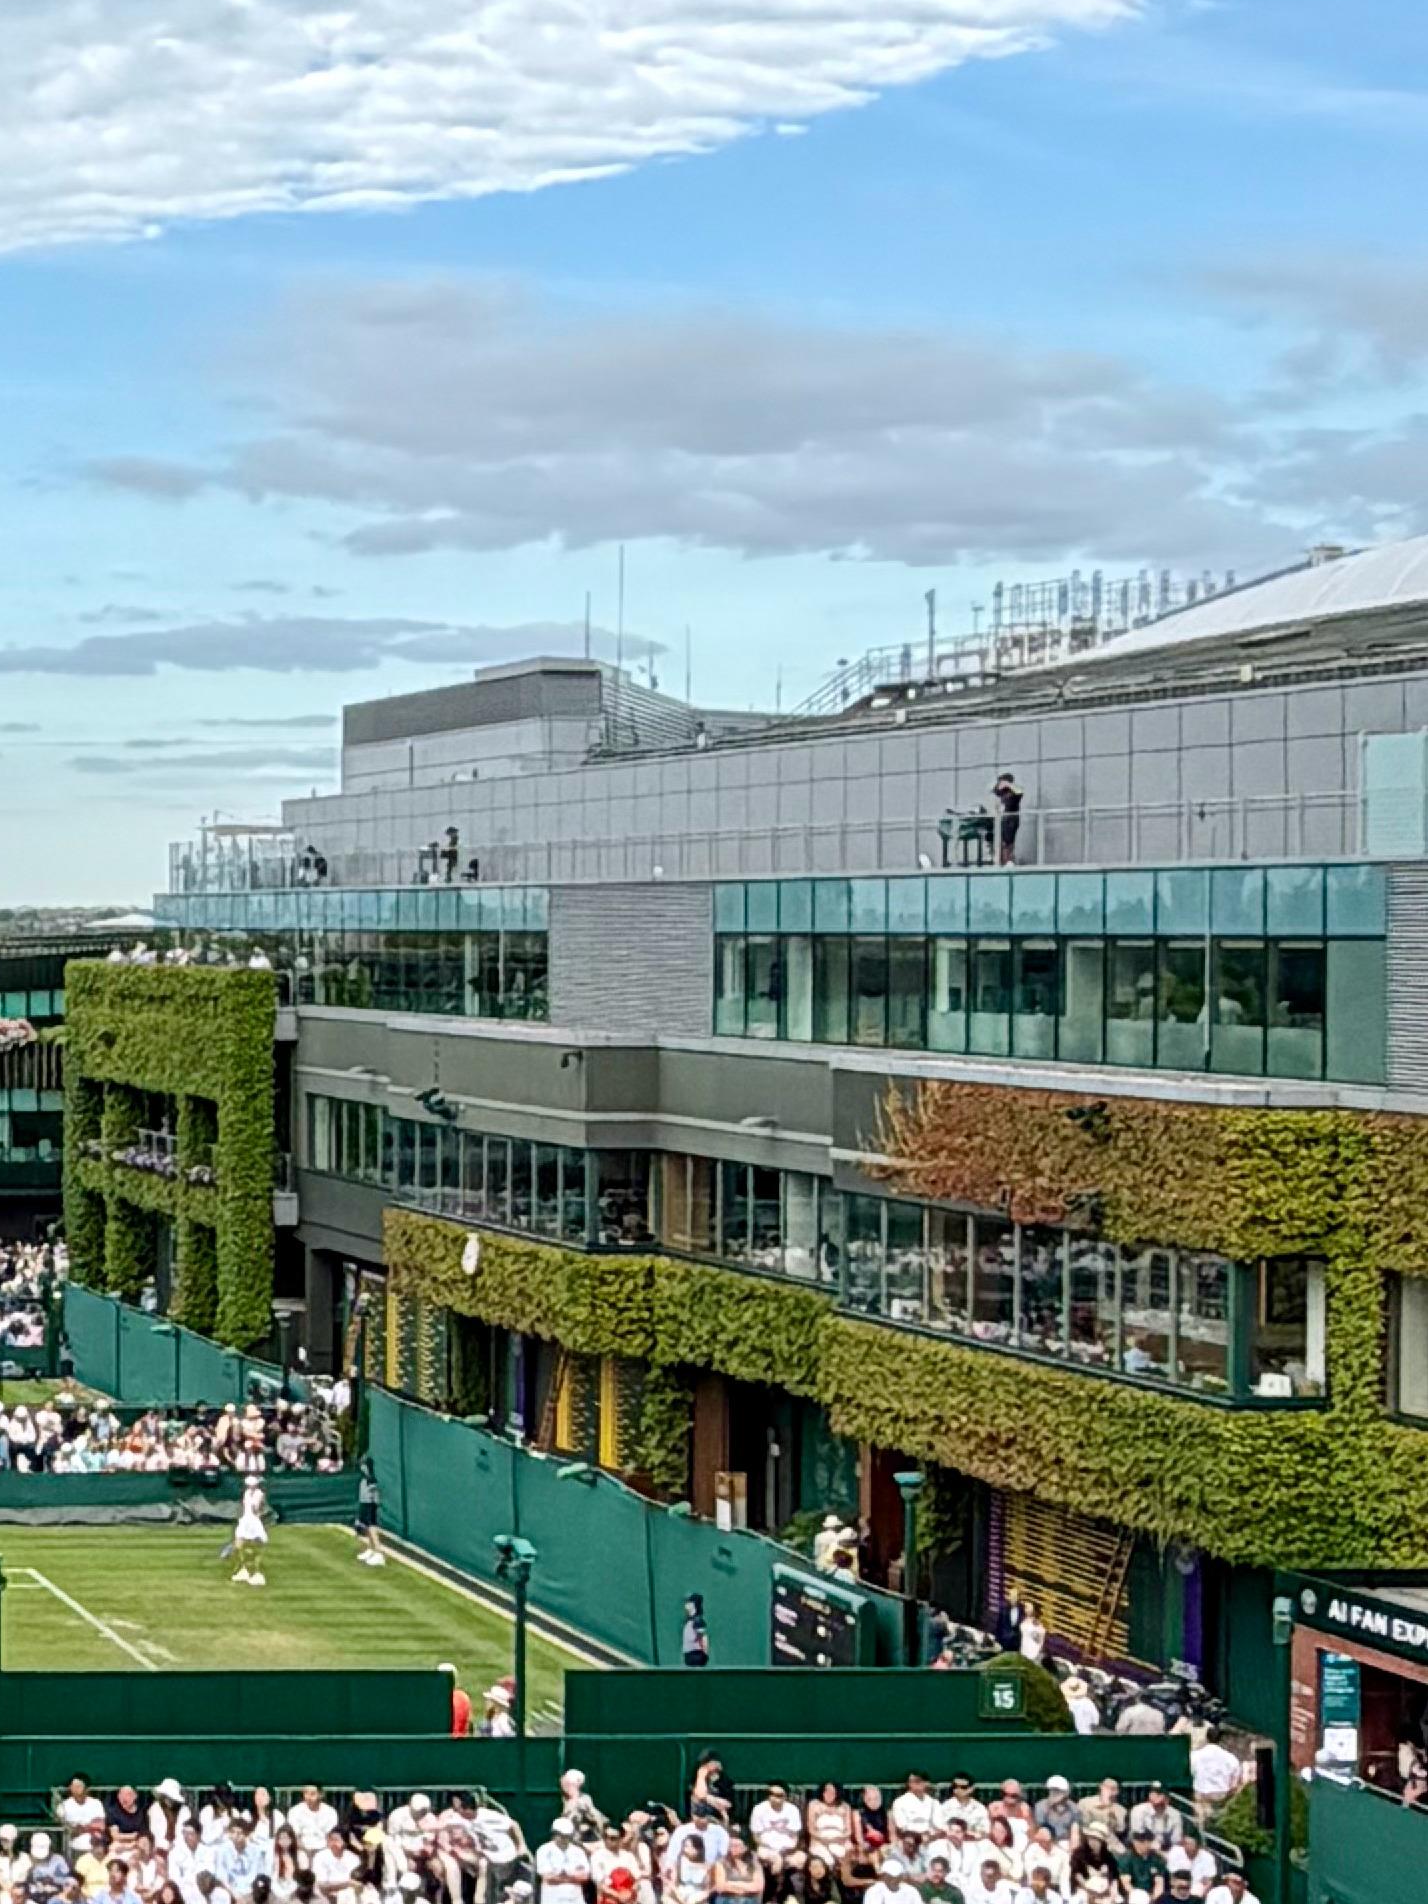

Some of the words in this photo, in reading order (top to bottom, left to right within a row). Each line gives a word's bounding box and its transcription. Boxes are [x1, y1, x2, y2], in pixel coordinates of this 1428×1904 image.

[1328, 1598, 1348, 1623] AI
[1350, 1605, 1388, 1636] FAN
[992, 1690, 1015, 1710] 15
